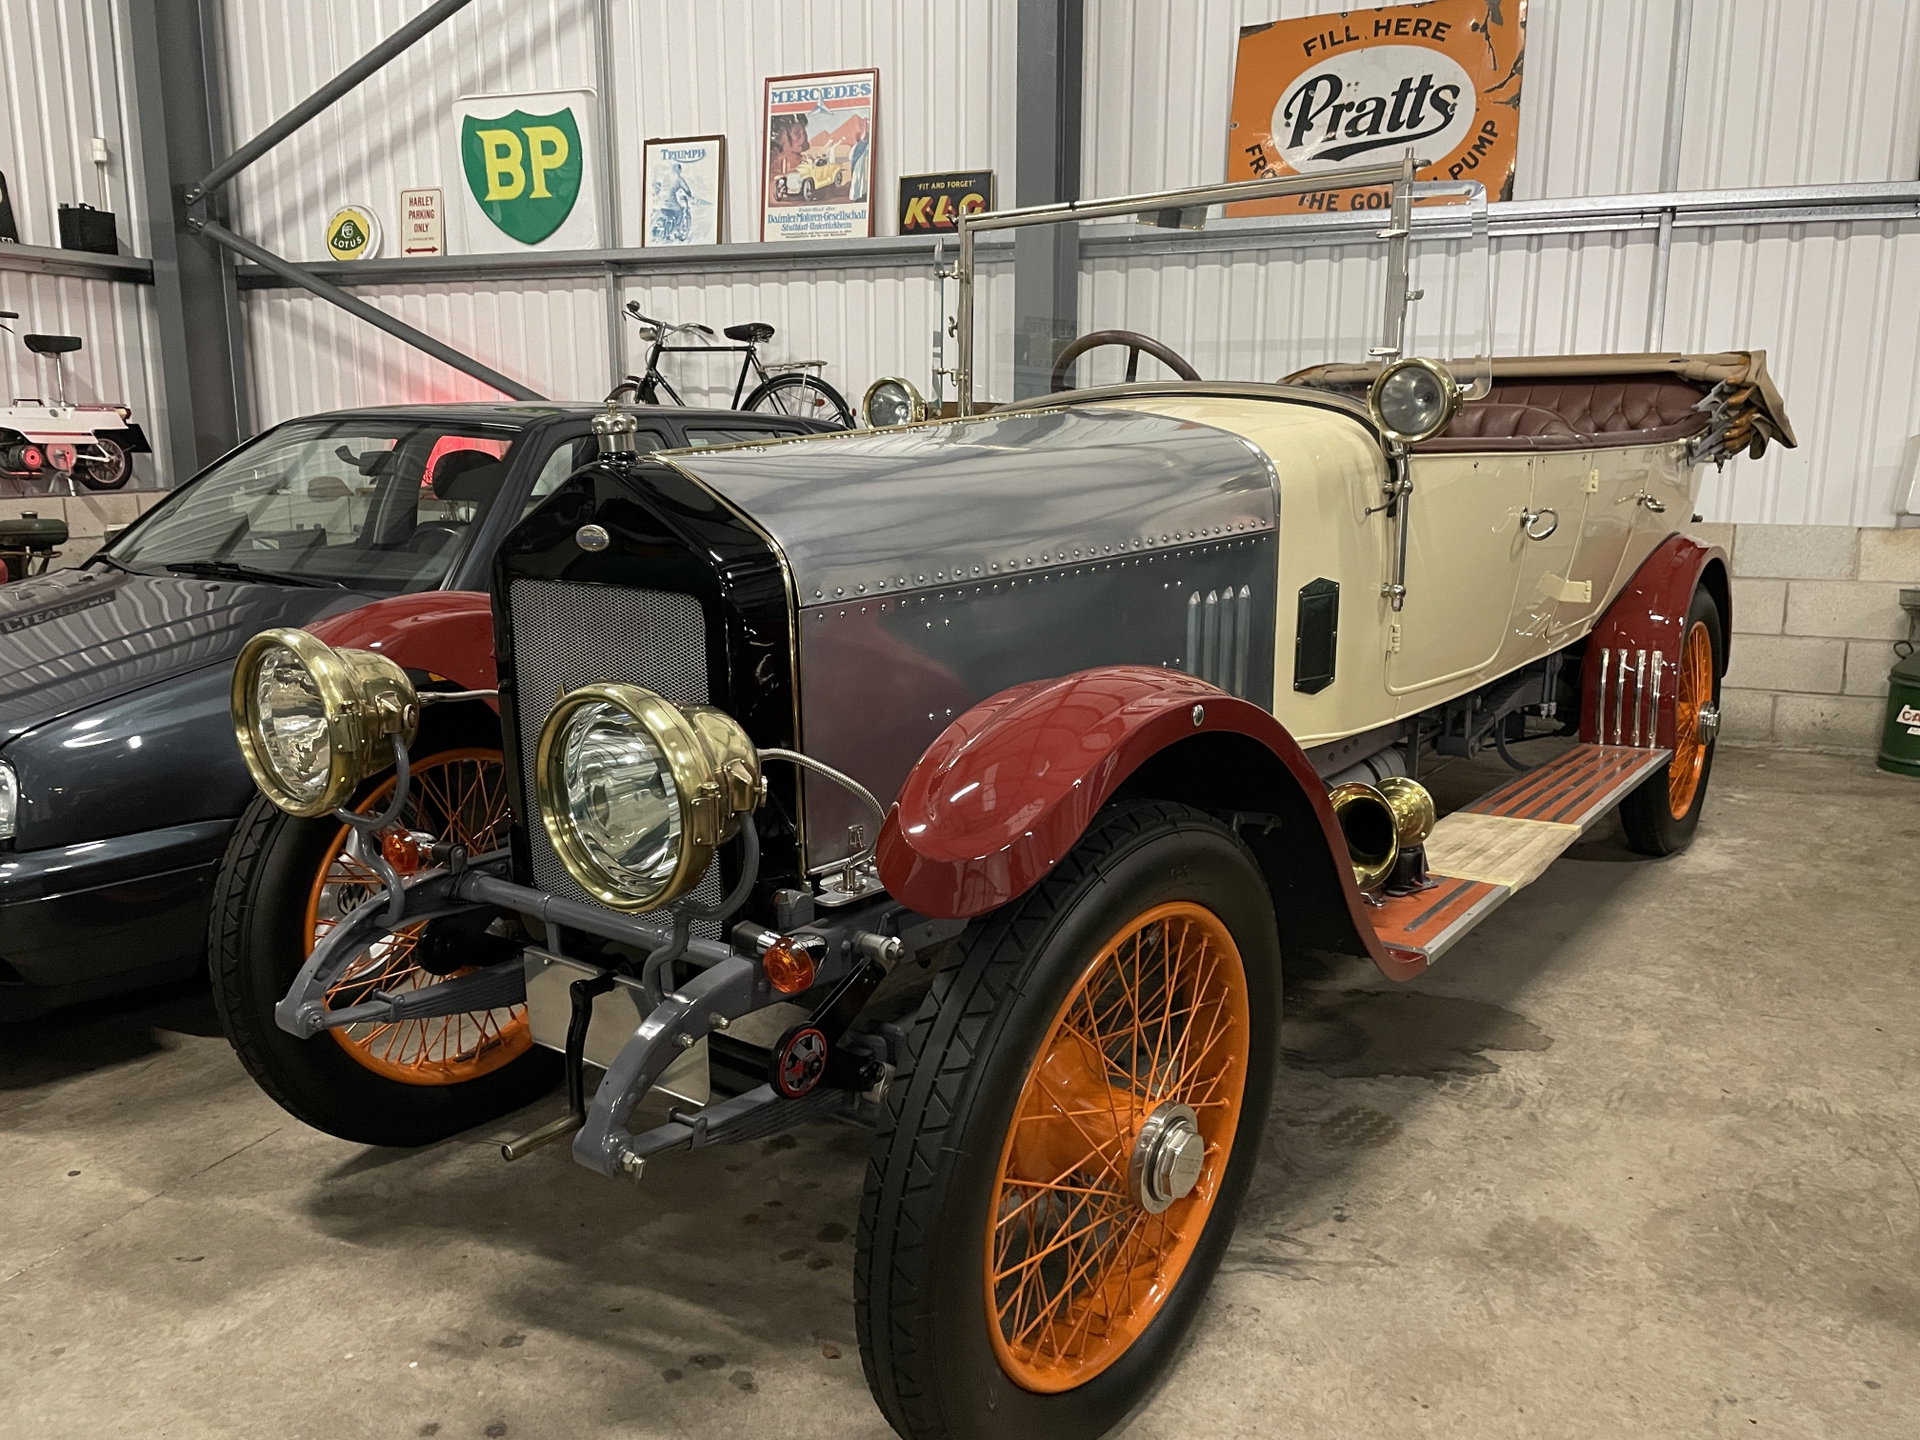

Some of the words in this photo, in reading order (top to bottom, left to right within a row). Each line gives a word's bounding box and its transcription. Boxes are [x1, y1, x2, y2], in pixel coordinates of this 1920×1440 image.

[1303, 26, 1359, 57] FILL
[1373, 18, 1452, 42] HERE
[771, 83, 872, 104] MERCEDES
[1284, 73, 1460, 161] Pratts
[475, 125, 569, 201] BP
[661, 149, 706, 162] TRIUMPH
[1245, 144, 1277, 179] FRO
[1351, 191, 1393, 211] GOL
[1448, 119, 1498, 180] PUMP
[408, 196, 434, 207] HARLEY
[408, 209, 434, 220] PARKING
[413, 223, 429, 233] ONLY
[333, 236, 362, 248] LOTUS
